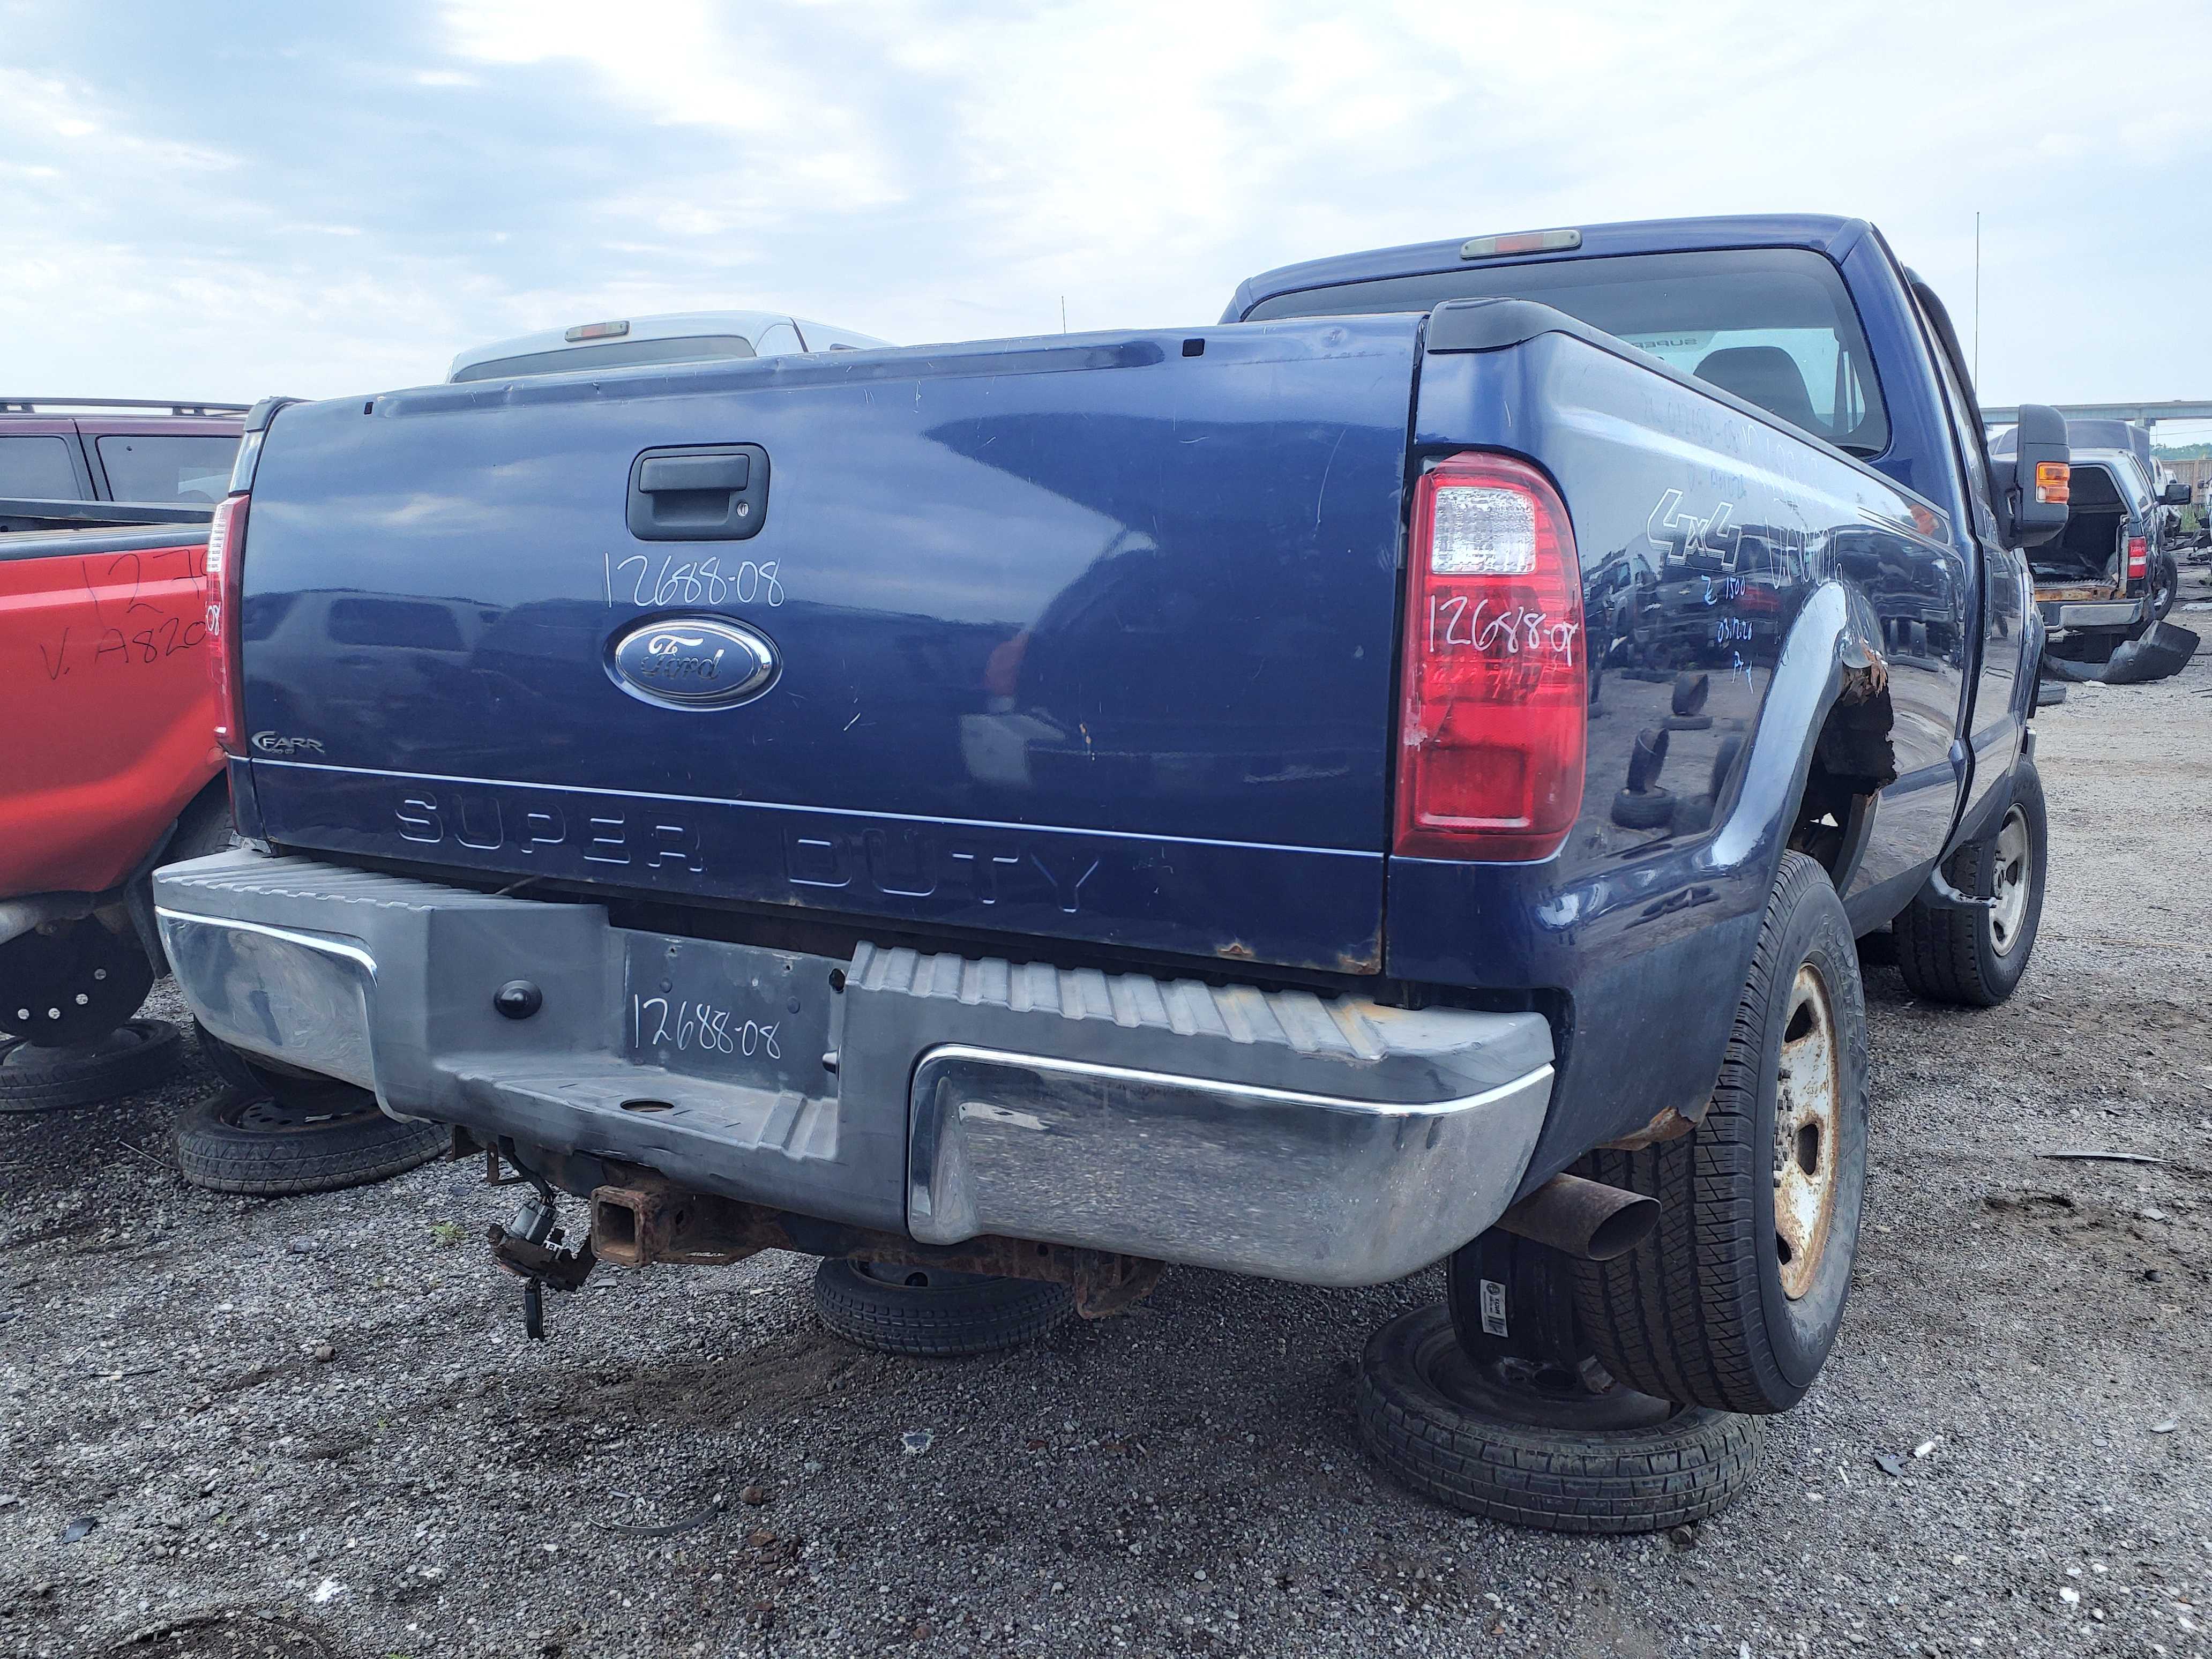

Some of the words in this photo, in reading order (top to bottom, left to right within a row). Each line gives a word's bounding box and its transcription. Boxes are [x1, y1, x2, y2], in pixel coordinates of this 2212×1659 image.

[602, 551, 785, 608] 12688-08
[641, 633, 725, 681] Ford
[395, 793, 703, 872] SUPER
[780, 828, 1100, 913] DUTY
[634, 994, 781, 1059] 12688-08
